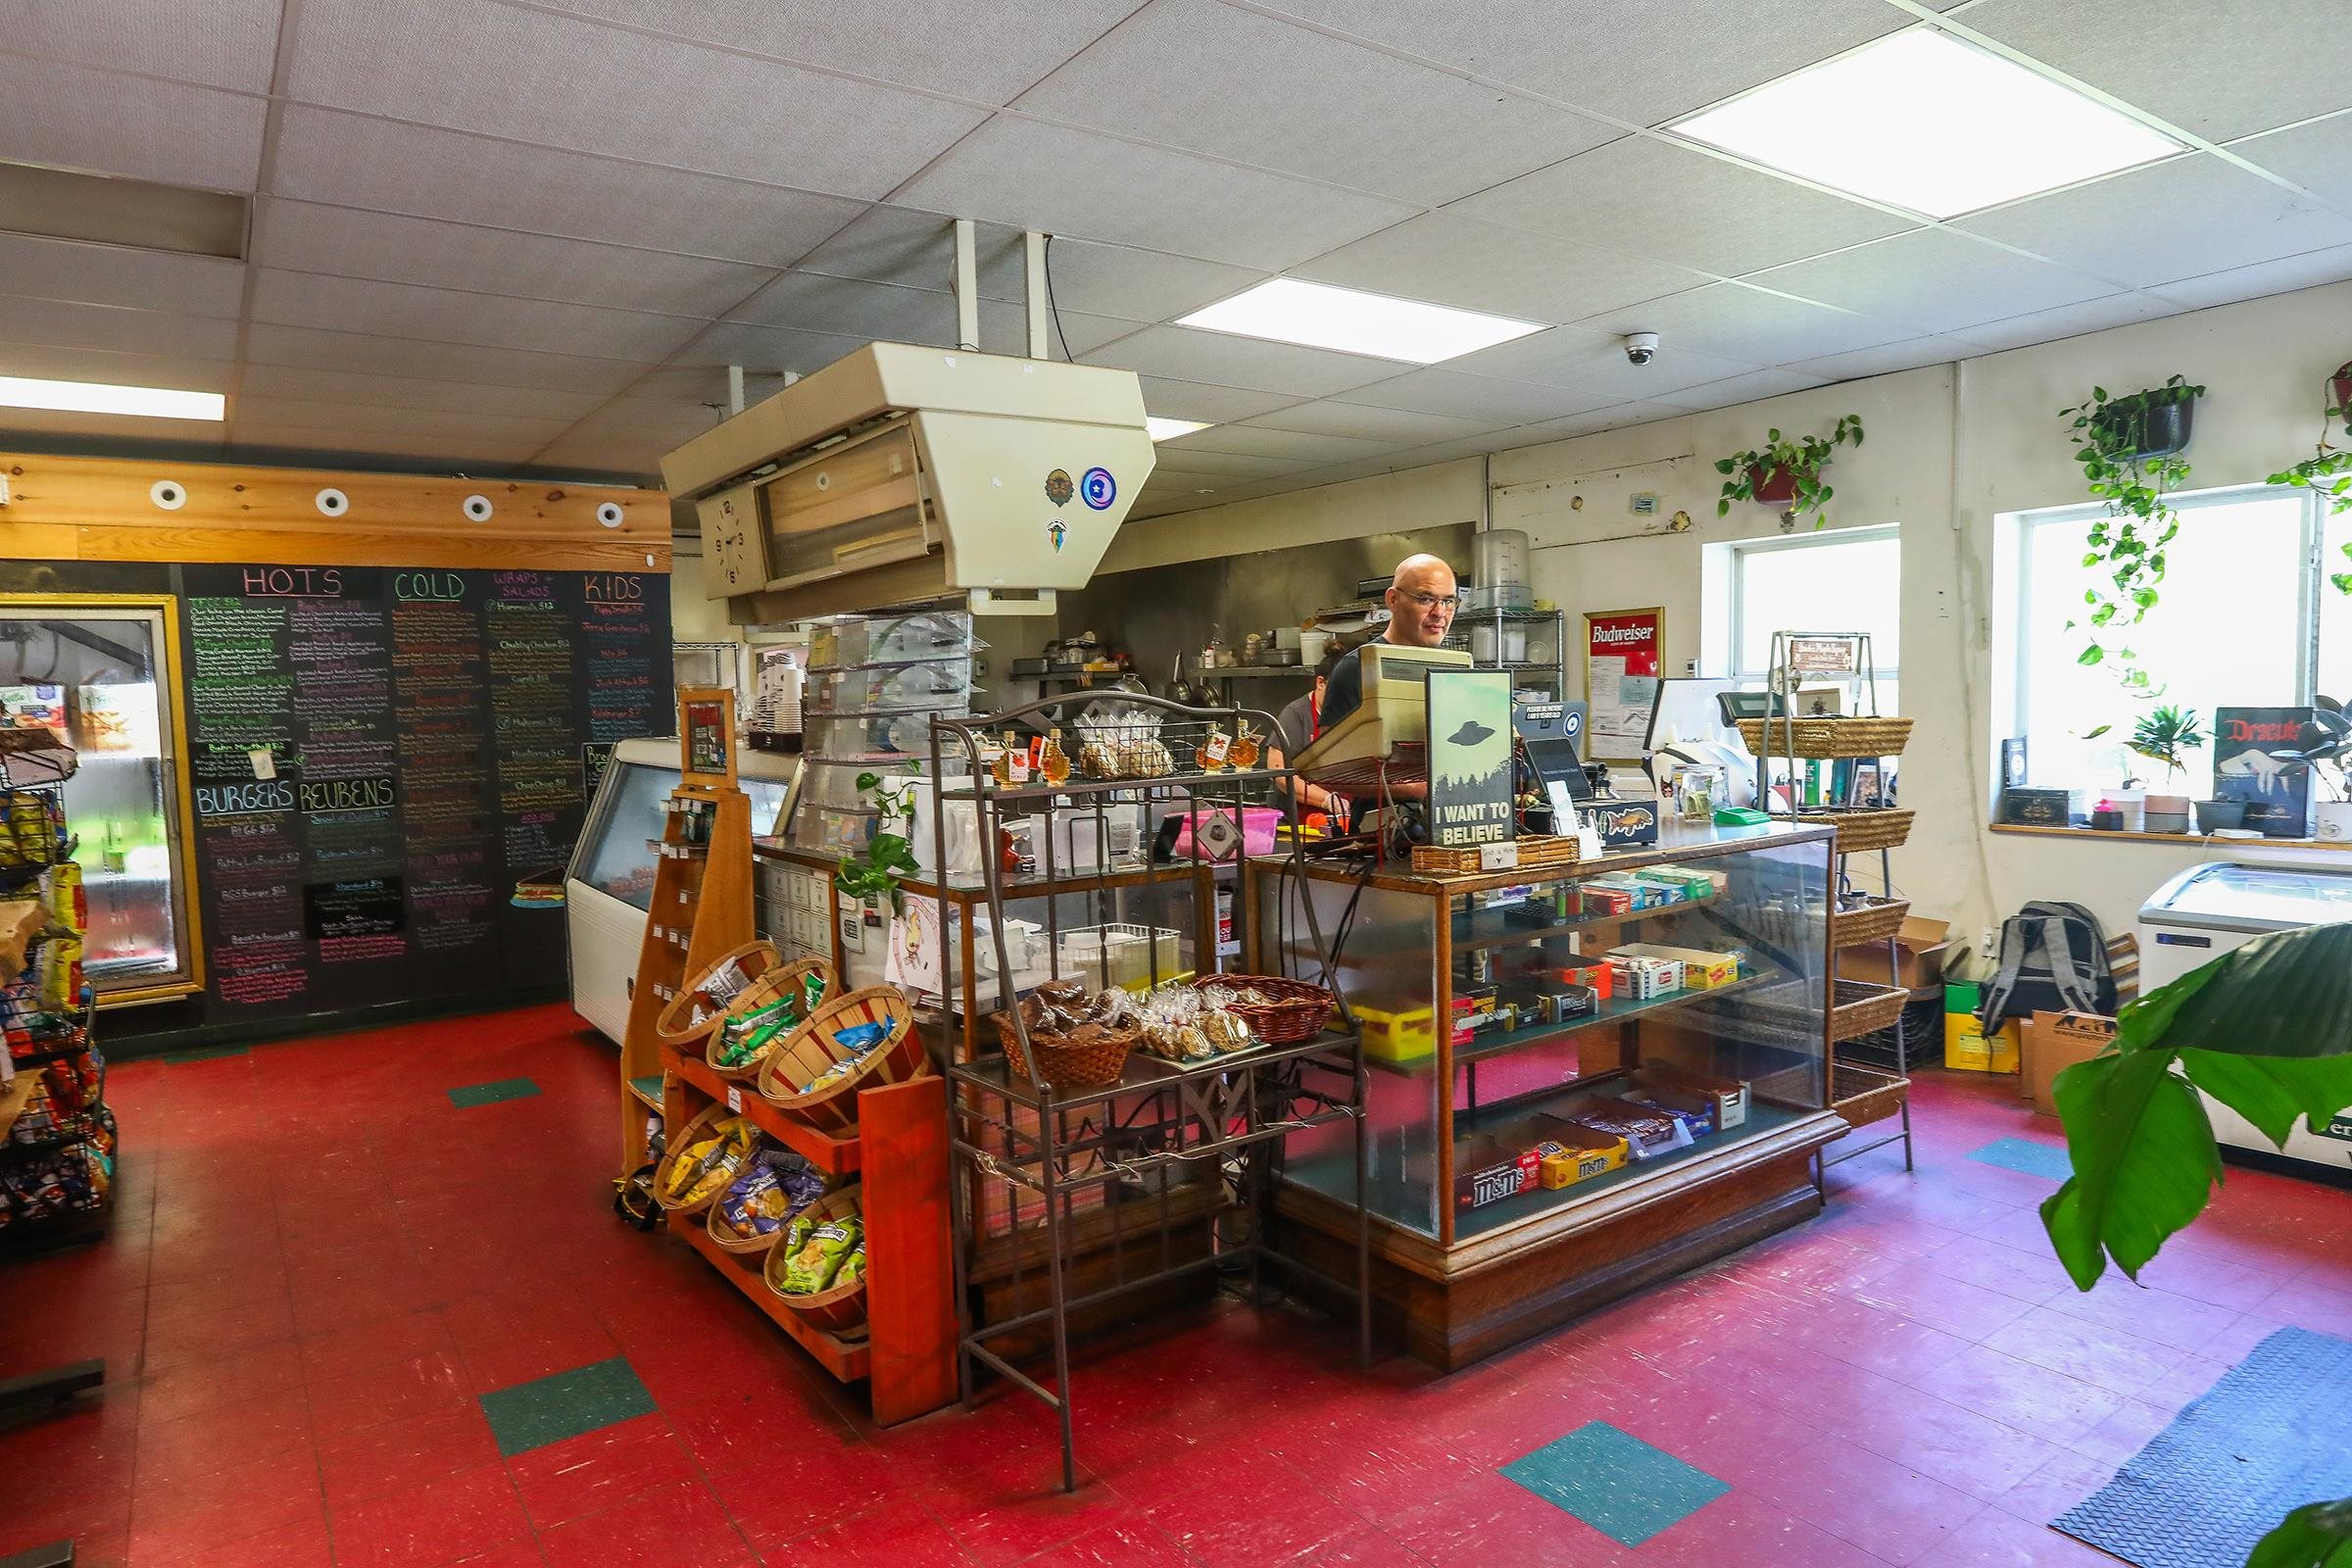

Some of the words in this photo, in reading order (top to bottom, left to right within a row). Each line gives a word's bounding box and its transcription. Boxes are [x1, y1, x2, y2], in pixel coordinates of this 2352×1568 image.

[243, 568, 342, 594] HOTS
[394, 573, 465, 598] COLD
[493, 572, 538, 585] WRAPS
[583, 575, 643, 600] KIDS
[502, 586, 551, 598] SALADS
[1592, 623, 1654, 644] Budweiser
[196, 780, 295, 812] BURGERS
[299, 778, 395, 811] REUBENS
[1435, 807, 1442, 824] I
[1444, 804, 1487, 823] WANT
[1490, 802, 1510, 820] TO
[1443, 823, 1504, 846] BELIEVE
